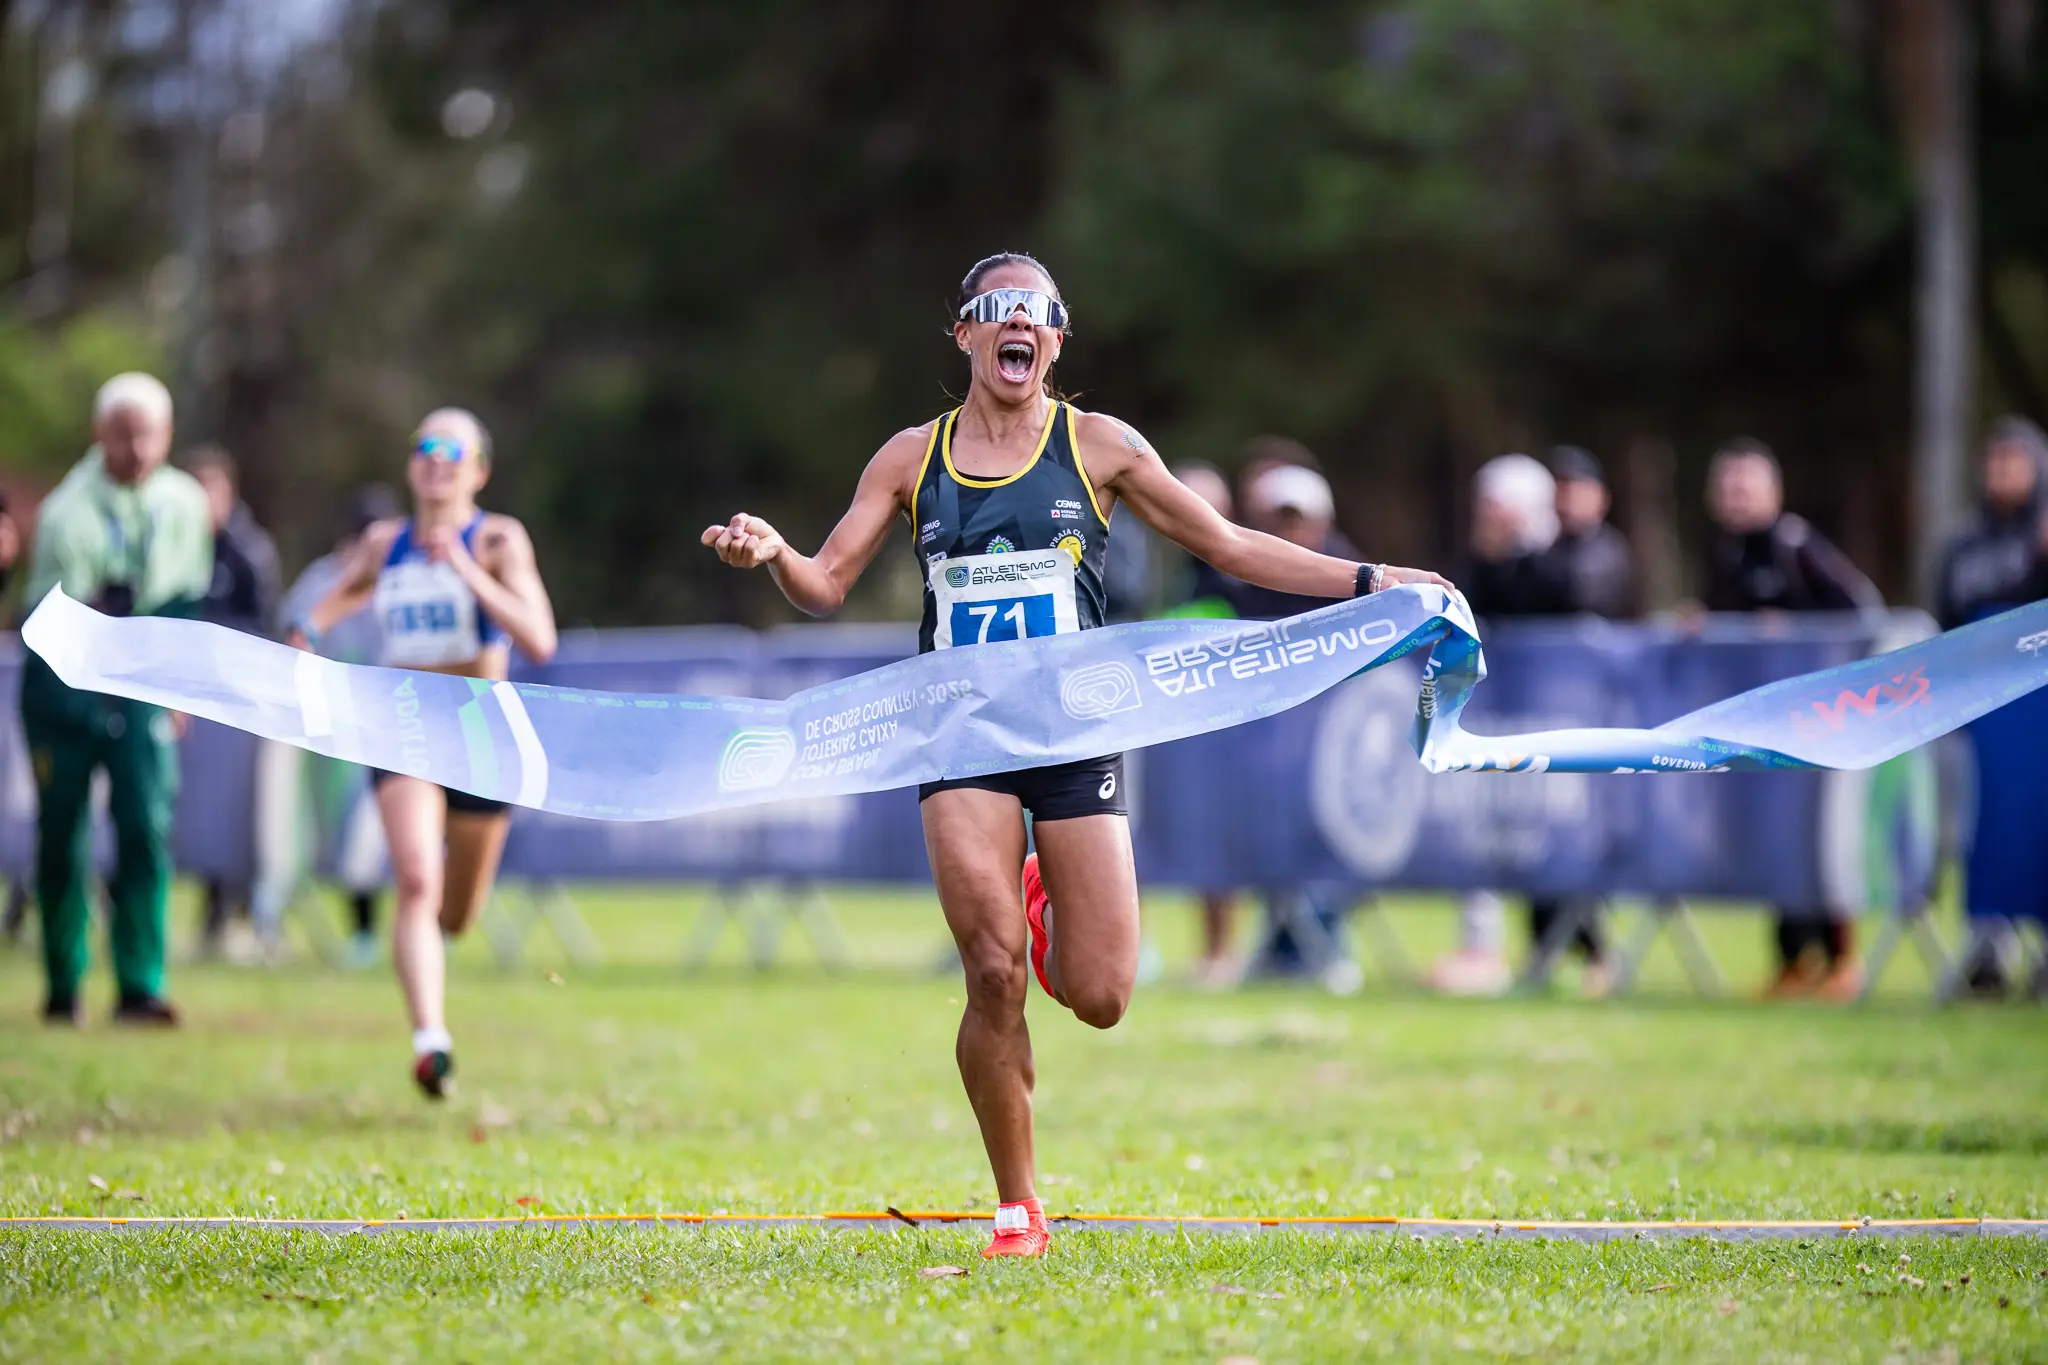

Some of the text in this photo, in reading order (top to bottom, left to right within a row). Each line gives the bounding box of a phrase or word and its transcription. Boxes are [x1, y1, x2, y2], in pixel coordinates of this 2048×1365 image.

[1049, 528, 1072, 548] PRAIA
[972, 559, 1057, 576] ATLETISMO
[972, 573, 1028, 585] BRASIL
[968, 601, 1028, 645] 71
[1387, 637, 1419, 661] ADULTO
[1651, 754, 1707, 771] GOVERNO
